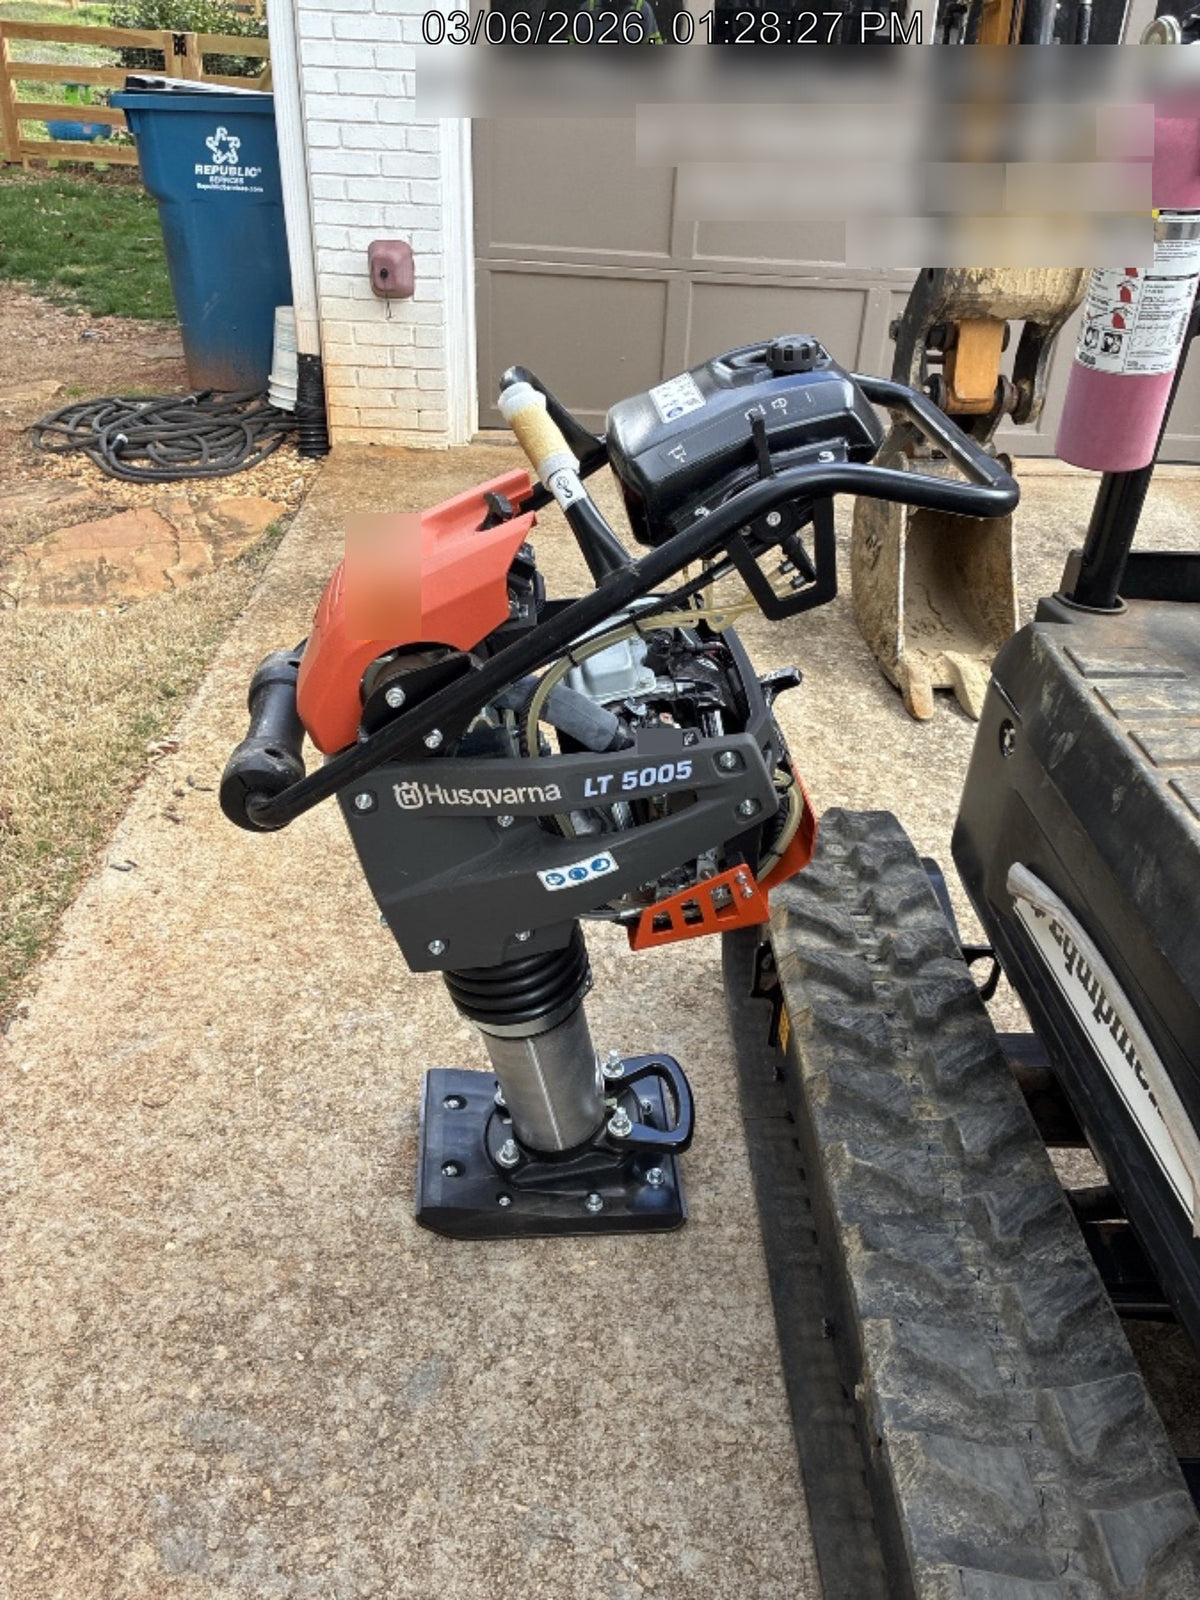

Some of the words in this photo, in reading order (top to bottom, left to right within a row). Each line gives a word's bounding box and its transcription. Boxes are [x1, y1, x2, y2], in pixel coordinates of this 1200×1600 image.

[584, 774, 615, 797] LT
[621, 760, 693, 790] 5005
[422, 783, 563, 808] Husqvarna
